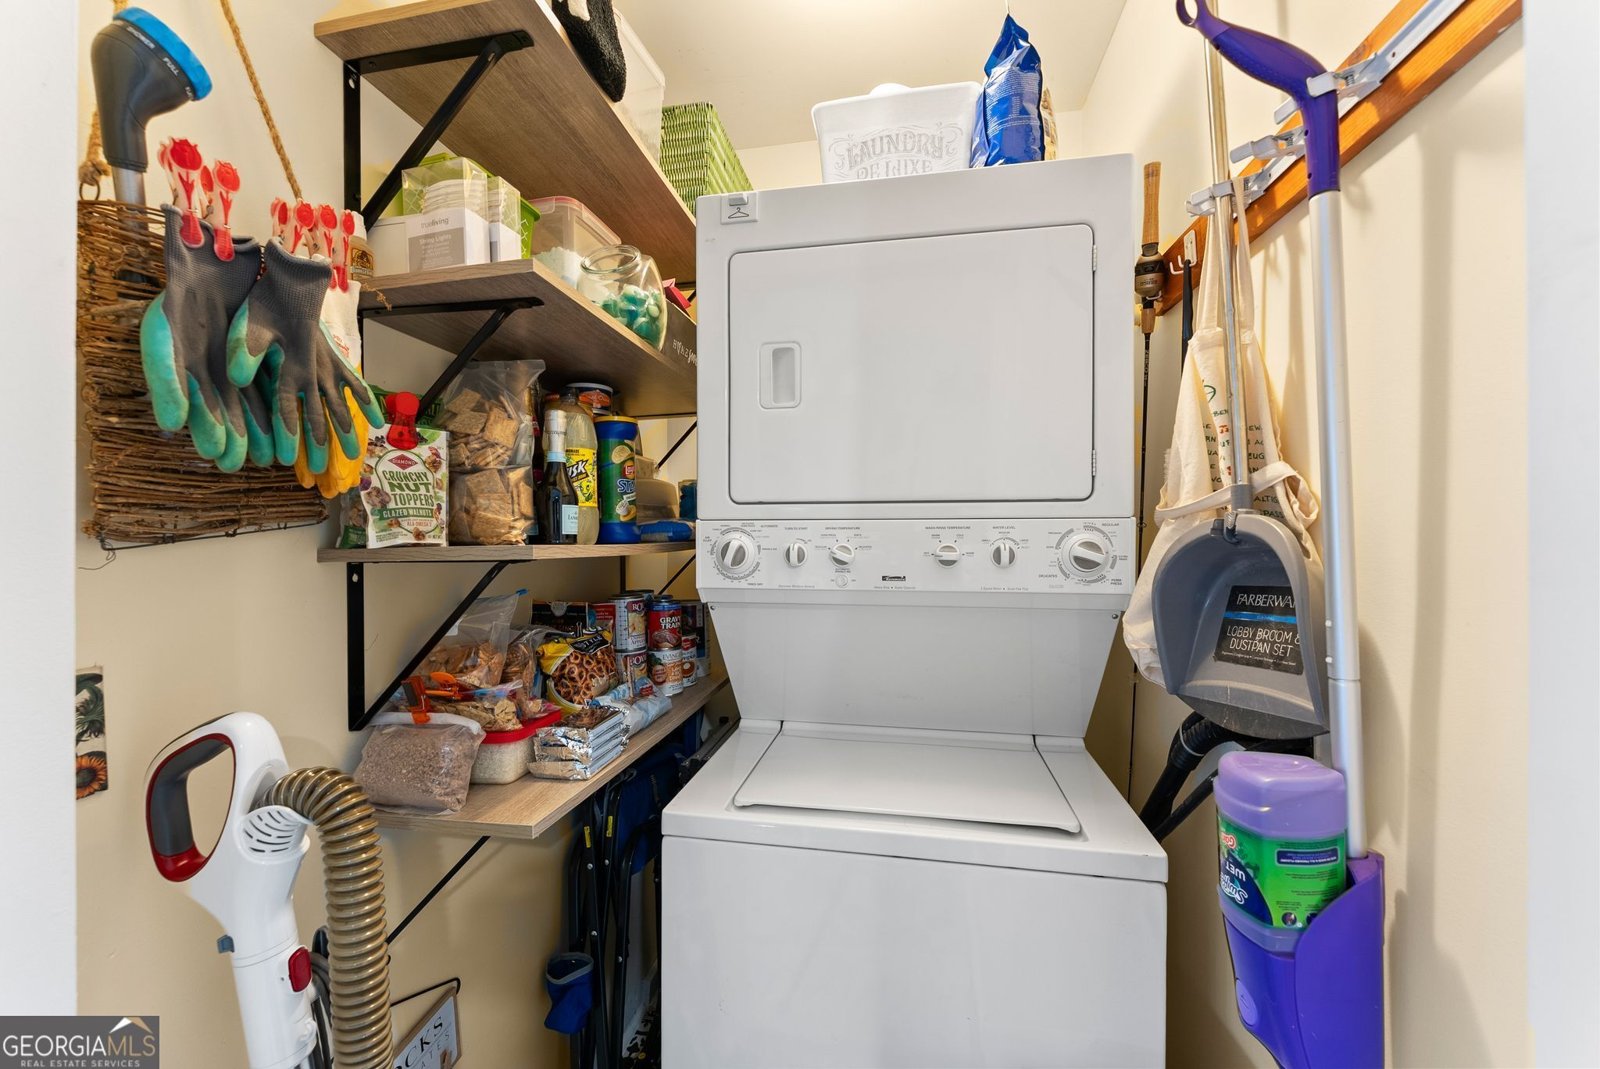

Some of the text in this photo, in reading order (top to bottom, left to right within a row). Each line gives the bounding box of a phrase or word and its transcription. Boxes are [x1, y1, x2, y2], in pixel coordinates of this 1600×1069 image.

[163, 57, 179, 76] FULL
[847, 131, 945, 170] LAUNDRY
[382, 470, 430, 482] CRUNCHY
[388, 482, 432, 493] NUT
[391, 493, 435, 507] TOPPERS
[383, 508, 432, 518] GLAZED WALNUTS
[1227, 625, 1256, 639] LOBBY
[1255, 628, 1293, 643] BROOM
[1229, 638, 1294, 657] DUSTPAN SET
[1225, 863, 1246, 882] WET
